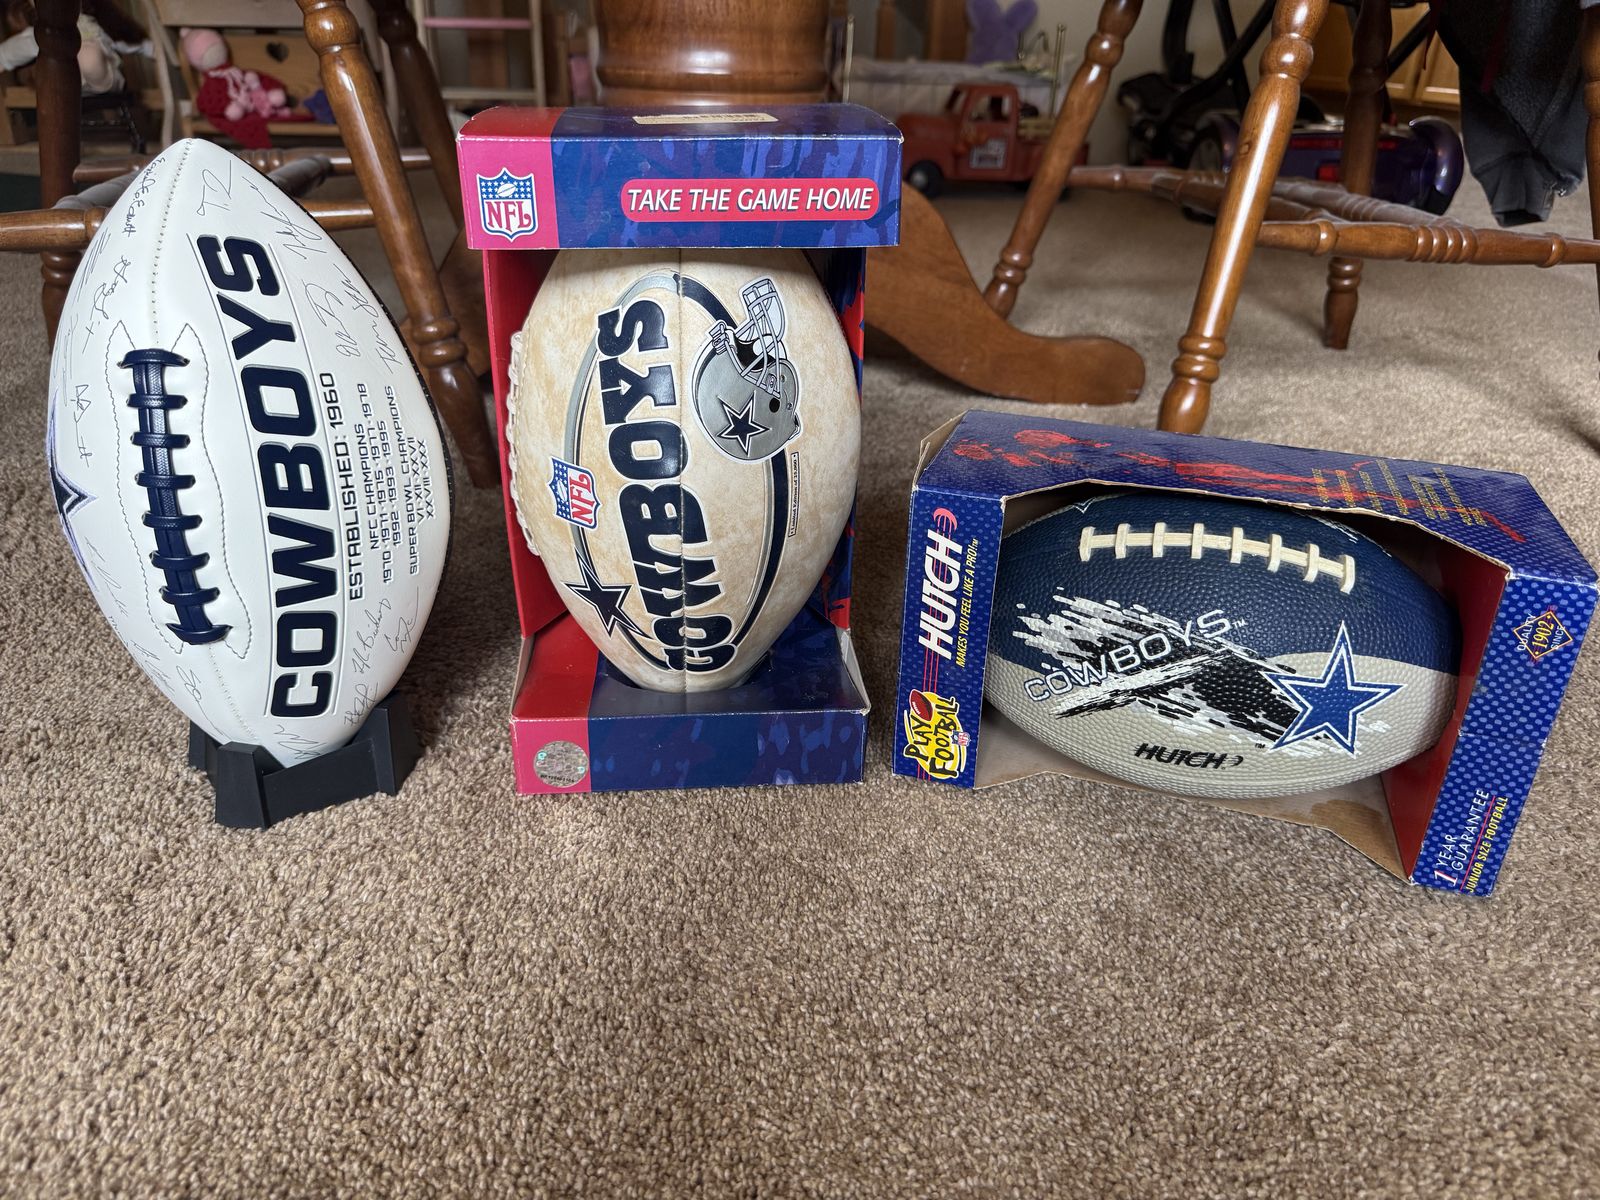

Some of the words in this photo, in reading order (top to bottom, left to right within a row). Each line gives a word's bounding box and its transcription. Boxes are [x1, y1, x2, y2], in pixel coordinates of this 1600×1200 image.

[486, 200, 533, 229] NFL
[627, 188, 683, 213] TAKE
[689, 188, 732, 213] THE
[737, 187, 802, 212] GAME
[806, 186, 875, 211] HOME
[319, 372, 344, 430] 1960
[357, 383, 373, 419] 1978
[377, 420, 391, 458] 1995
[384, 385, 409, 475] CHAMPIONS
[196, 234, 337, 719] COWBOYS
[354, 423, 377, 516] CHAMPIONS
[596, 299, 738, 673] COWBOYS
[403, 478, 415, 523] BOWL
[569, 473, 596, 525] NFL
[334, 435, 363, 601] ESTABLISHED:
[368, 519, 380, 550] NFC
[390, 510, 401, 547] 1992
[382, 550, 392, 584] 1970
[409, 526, 418, 575] SUPER
[962, 576, 975, 597] LIKE
[967, 568, 975, 578] A
[918, 528, 963, 661] HUTCH
[960, 597, 972, 618] FEEL
[958, 617, 971, 636] YOU
[1516, 613, 1536, 651] QUALITY
[1531, 620, 1555, 649] 1902
[1550, 625, 1566, 650] SINCE
[955, 636, 968, 668] MAKES
[1023, 608, 1232, 702] COWBOYS
[905, 714, 932, 762] PLAY
[929, 697, 959, 777] FOOTBALL
[1133, 742, 1229, 770] HUTCH
[1451, 789, 1490, 871] GUARANTEE
[1484, 796, 1508, 841] FOOTBALL
[1435, 834, 1458, 867] YEAR
[1477, 841, 1492, 862] SIZE
[1434, 869, 1458, 887] 1
[1465, 862, 1484, 893] JUNIOR
